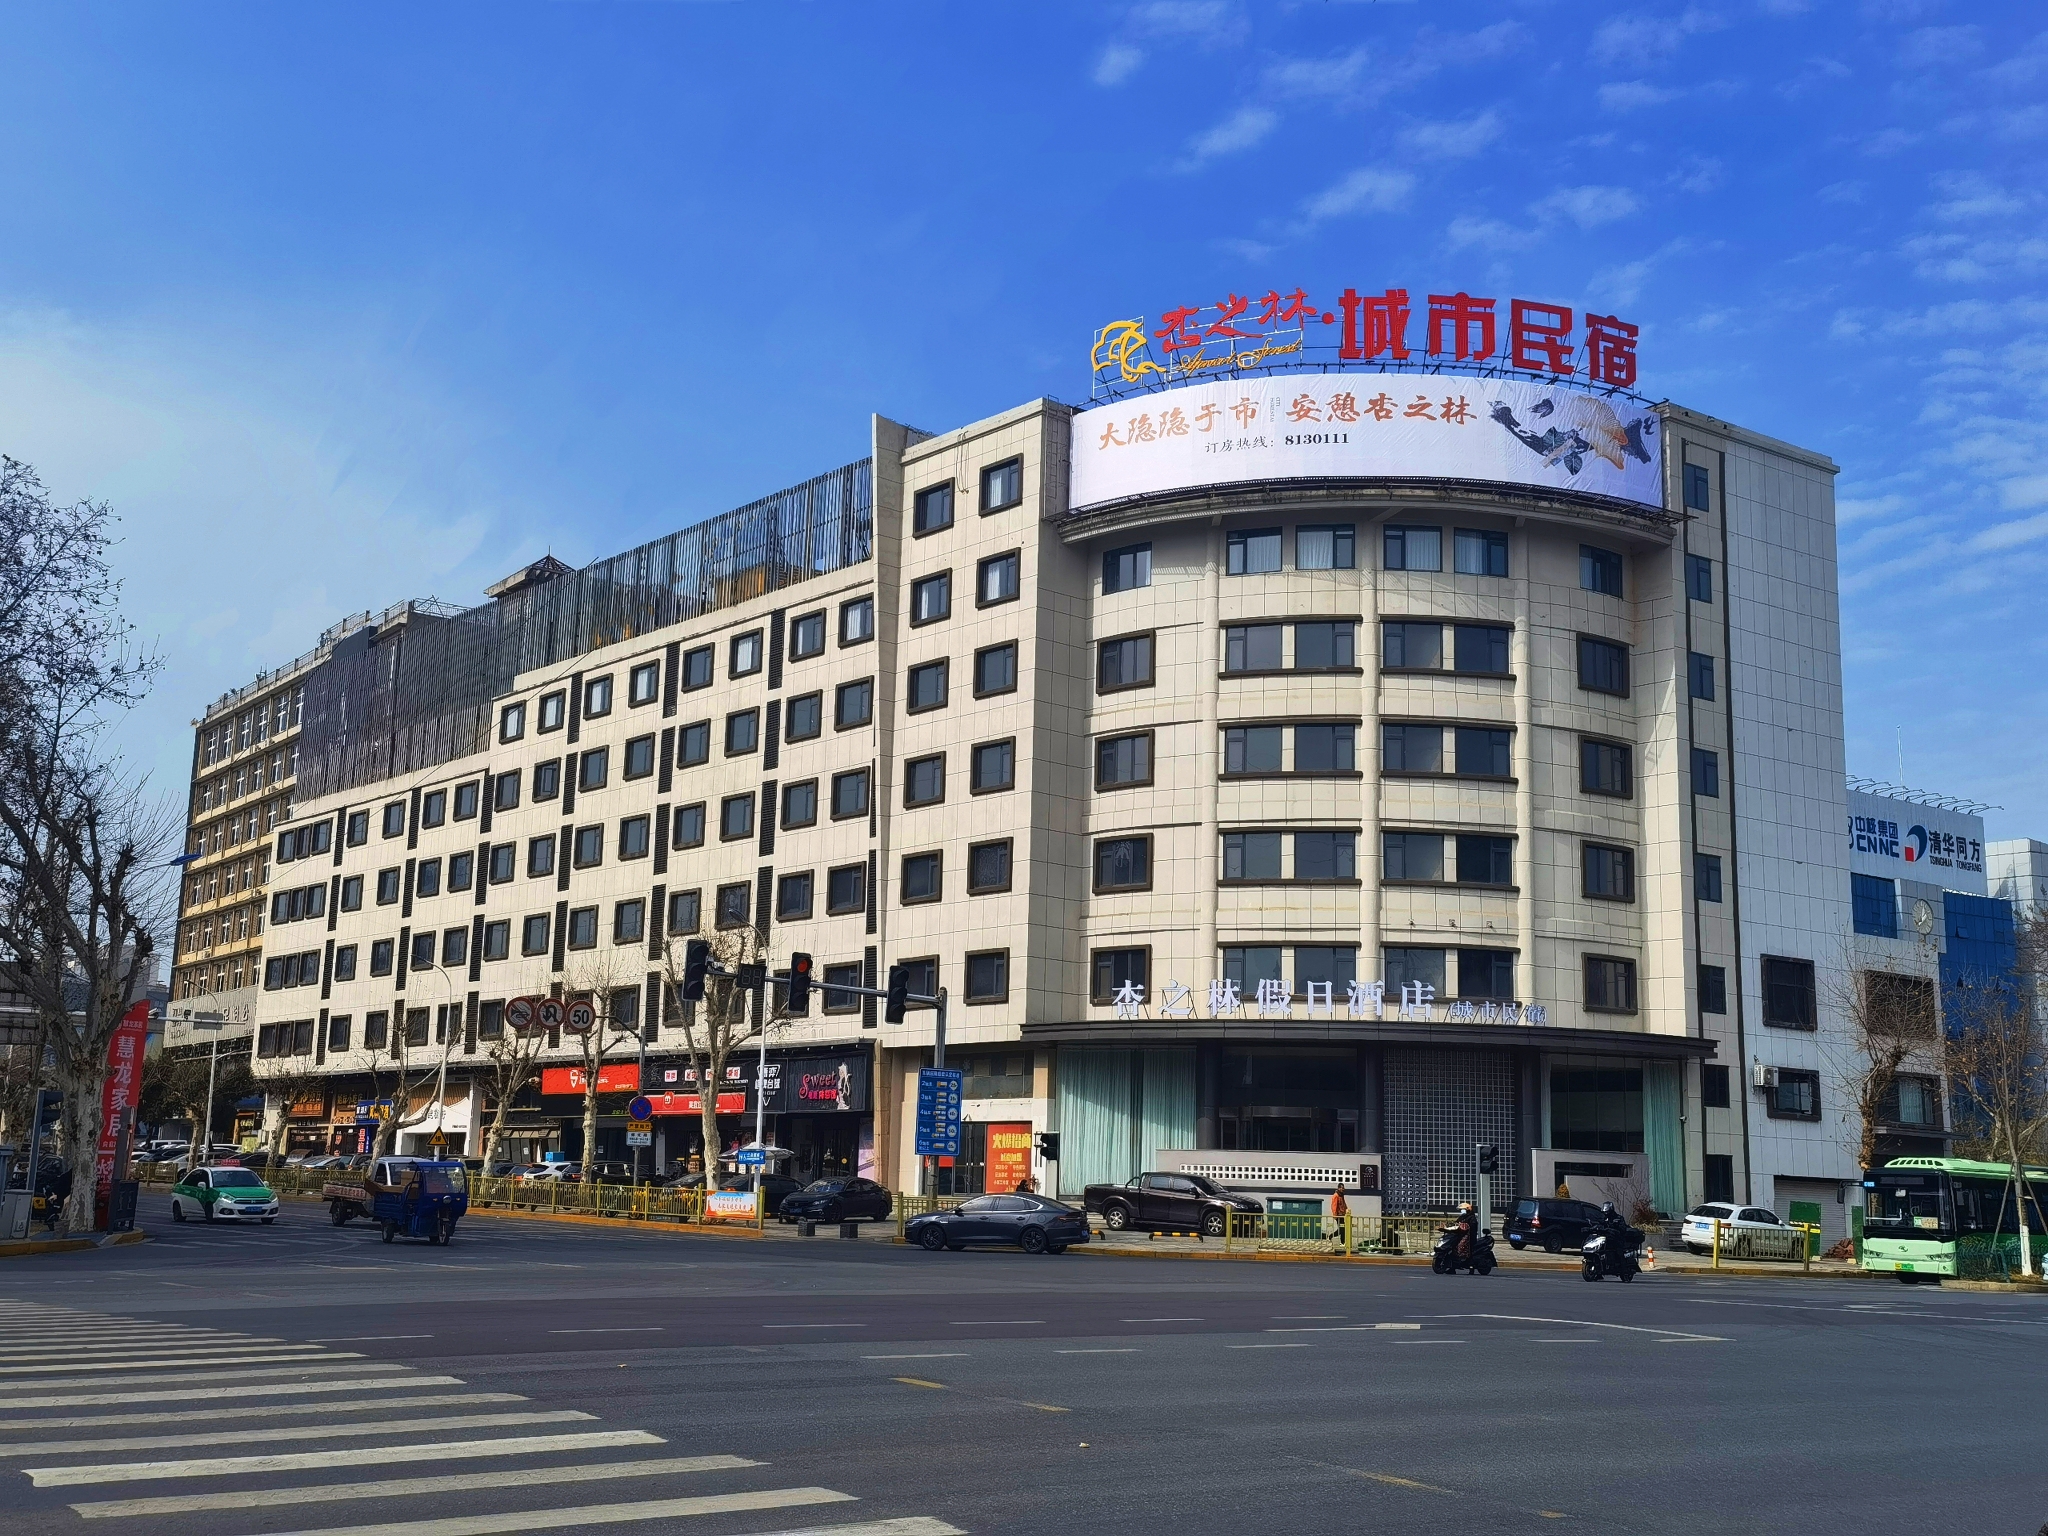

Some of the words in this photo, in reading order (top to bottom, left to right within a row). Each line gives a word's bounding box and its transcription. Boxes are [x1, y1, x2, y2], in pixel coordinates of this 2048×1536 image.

[1285, 392, 1478, 425] 安憩杏之林
[1098, 397, 1259, 450] 大隐隐于市
[1285, 433, 1350, 446] 8130111
[1855, 816, 1898, 840] 中核集团
[1856, 834, 1900, 858] CNNC
[1929, 829, 1981, 862] 清华同方
[1930, 855, 1953, 868] TSINGHUA
[1956, 859, 1982, 873] TONGFANG
[1112, 979, 1435, 1019] 杏之林假日酒店
[573, 1010, 589, 1024] 50
[107, 1036, 135, 1137] 慧龙家居
[799, 1071, 836, 1099] Sweet
[992, 1132, 1032, 1149] 火爆招商
